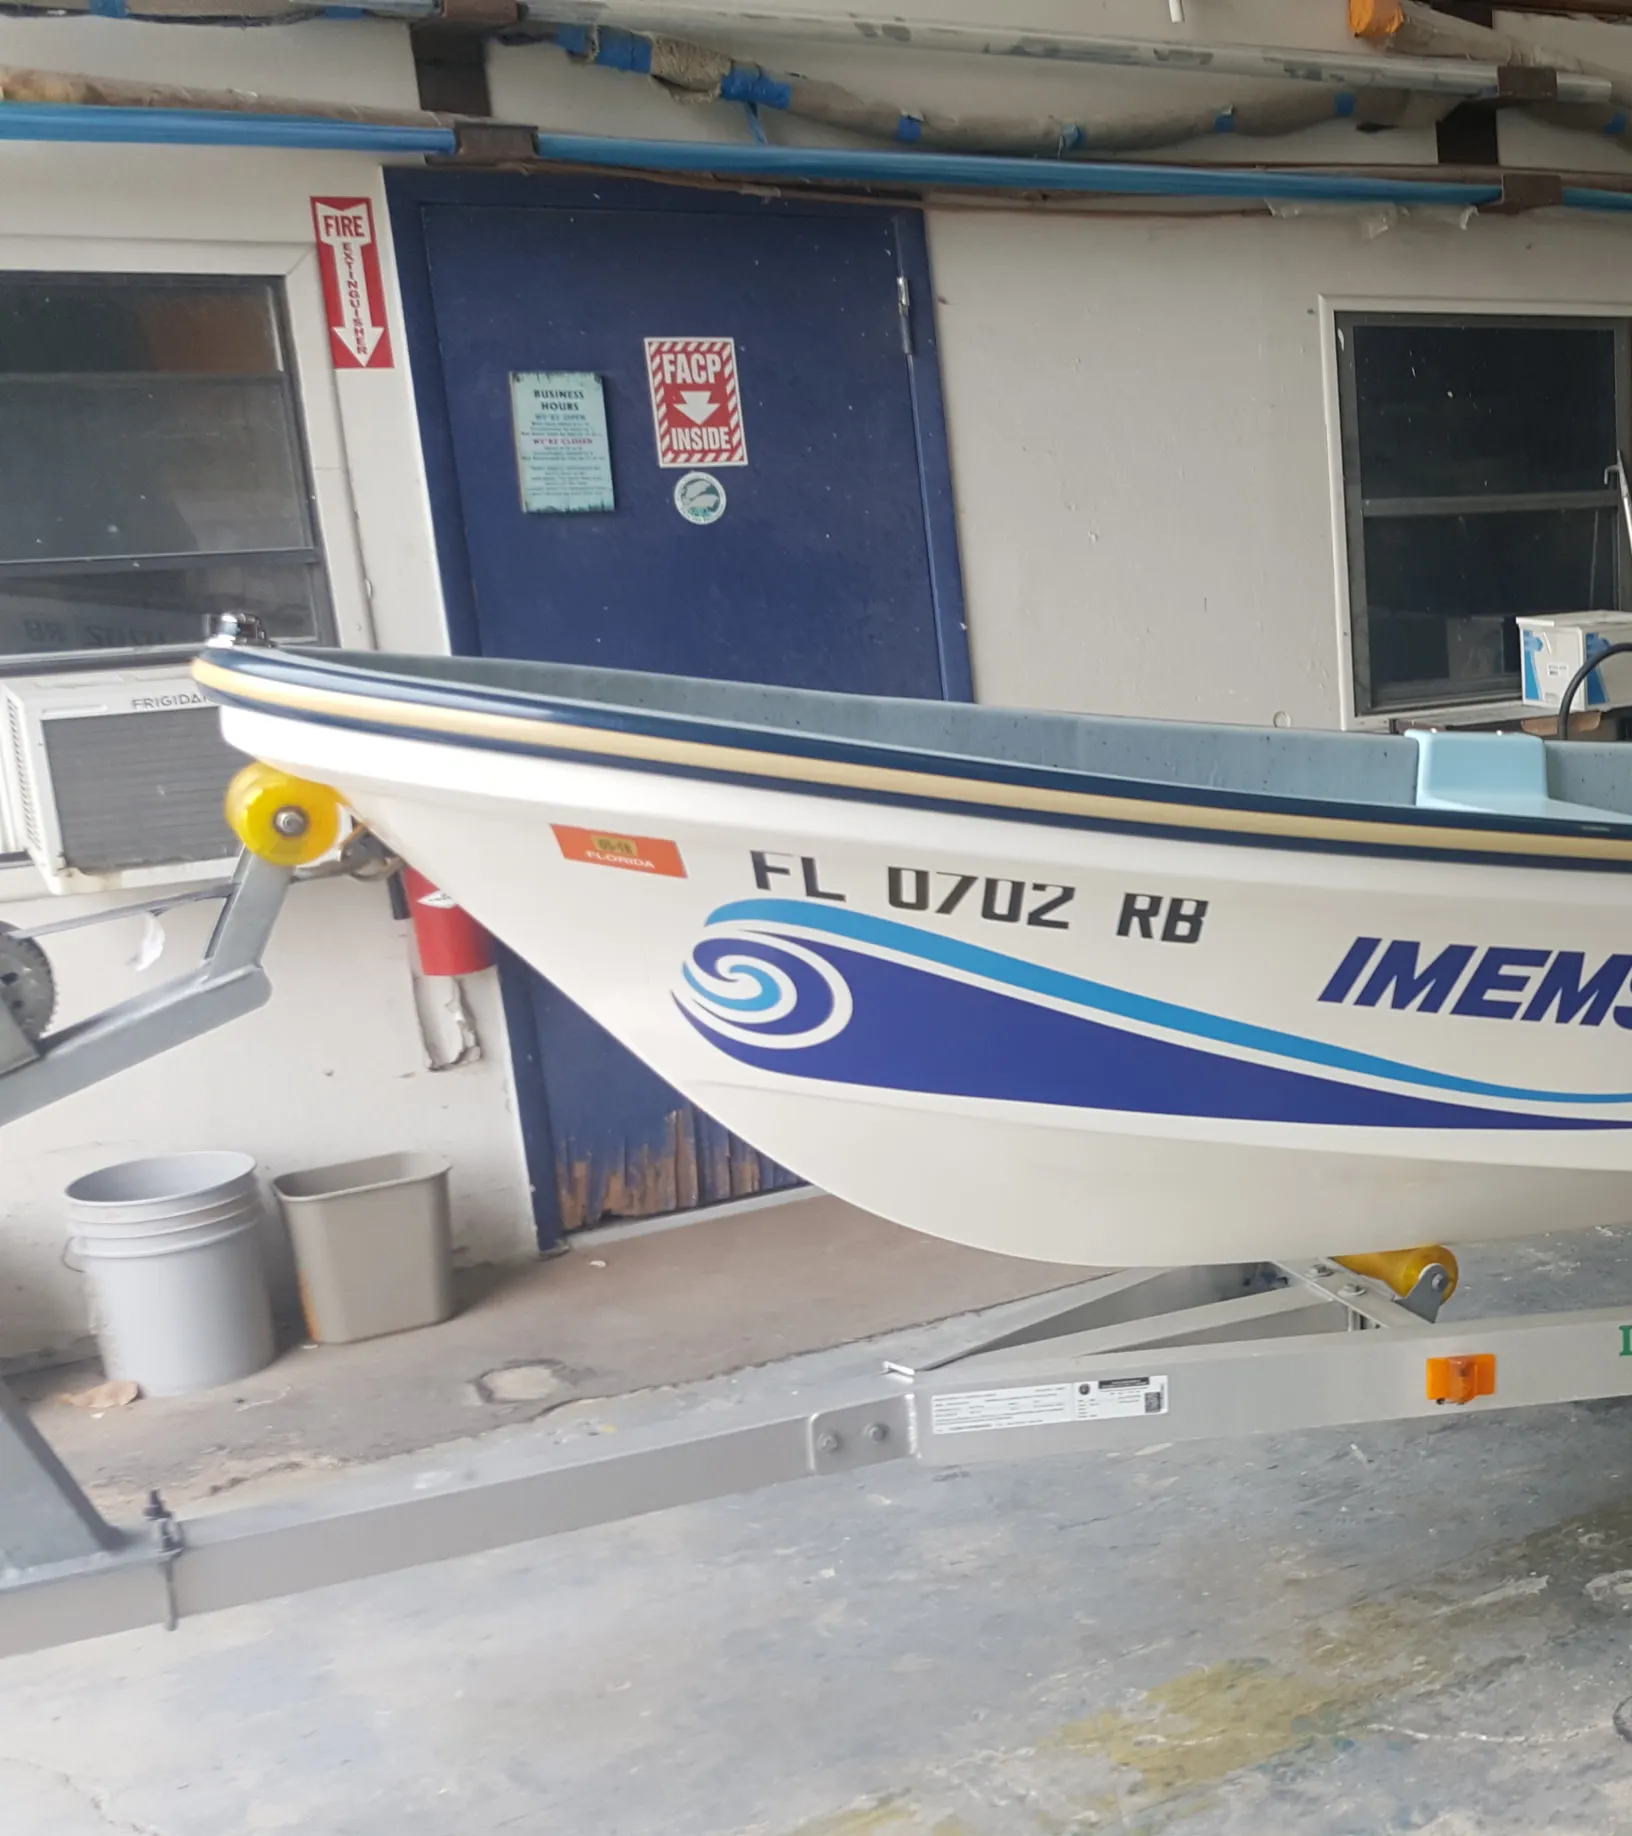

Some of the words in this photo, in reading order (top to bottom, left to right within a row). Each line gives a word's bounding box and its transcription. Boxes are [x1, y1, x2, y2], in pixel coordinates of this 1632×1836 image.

[323, 215, 365, 237] FIRE
[342, 241, 368, 355] EXTINGUISHER
[661, 352, 722, 385] FACP
[533, 389, 585, 399] BUSINESS
[540, 401, 580, 411] HOURS
[670, 426, 732, 451] INSIDE
[586, 850, 656, 869] FLORIDA
[749, 850, 847, 902] FL
[886, 866, 1076, 930] 0702
[1115, 891, 1210, 944] RB
